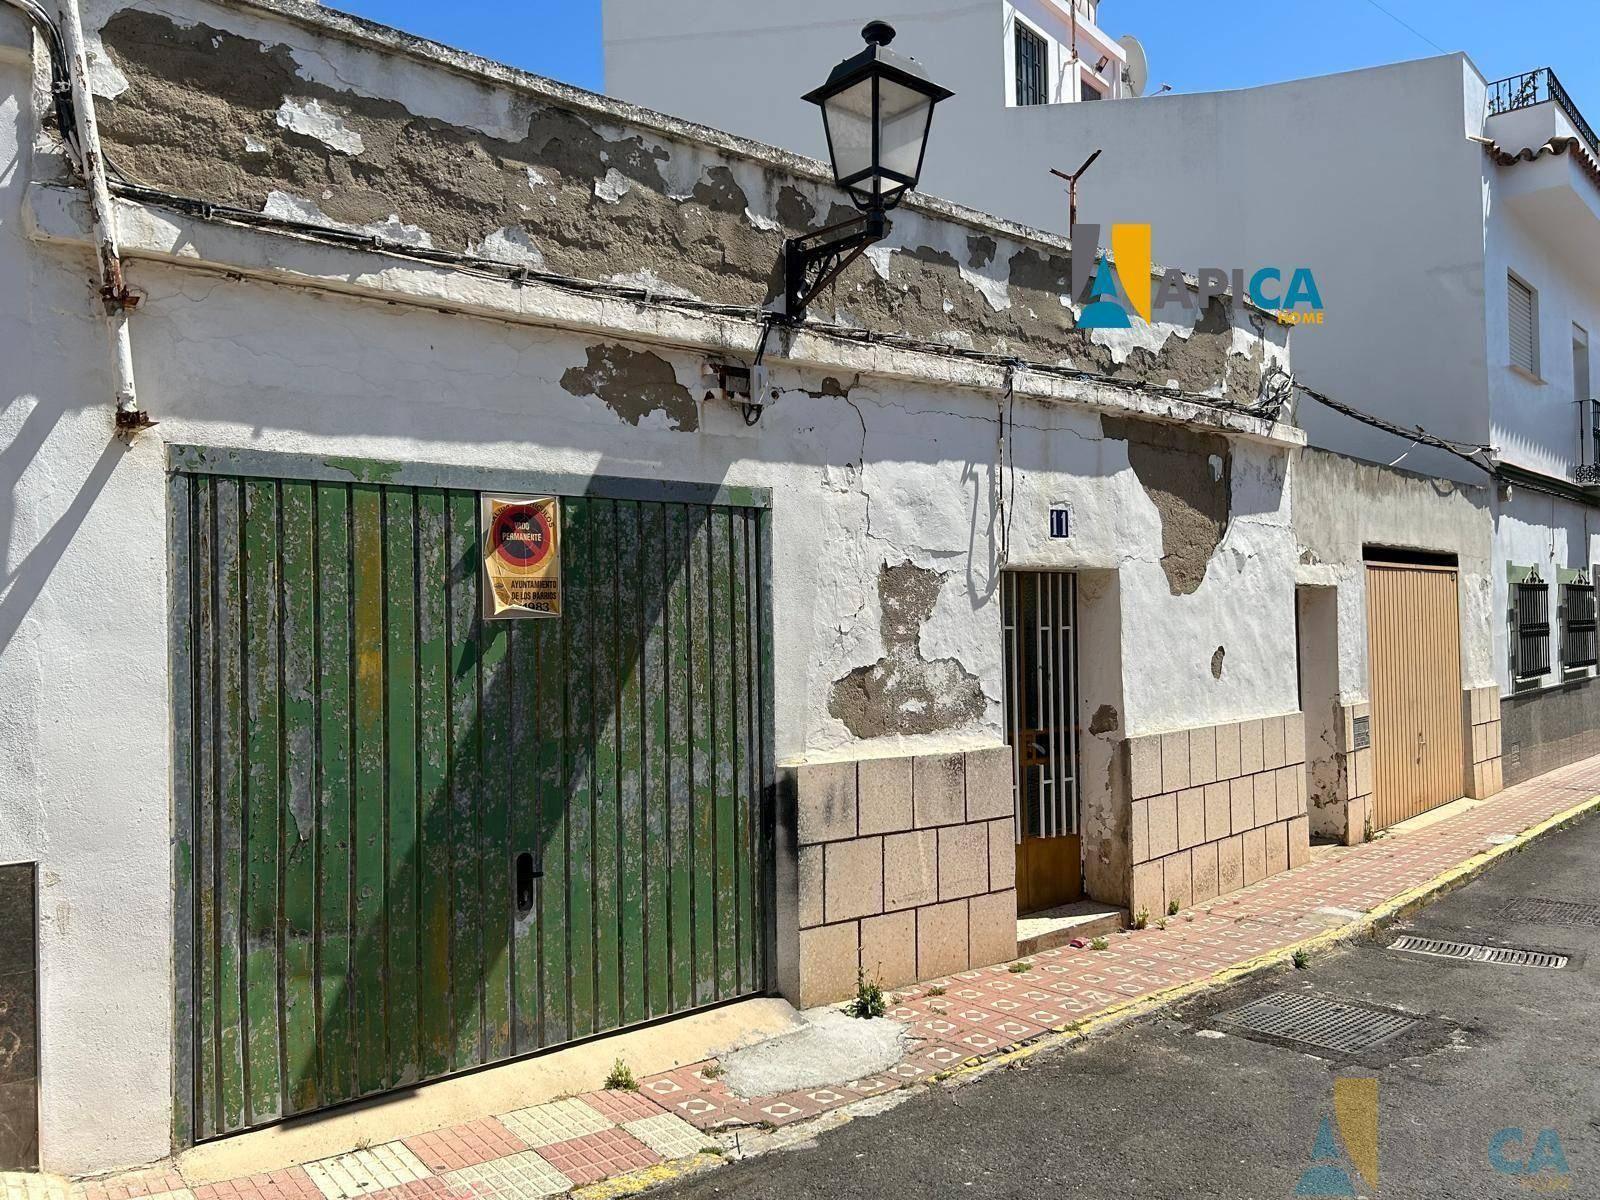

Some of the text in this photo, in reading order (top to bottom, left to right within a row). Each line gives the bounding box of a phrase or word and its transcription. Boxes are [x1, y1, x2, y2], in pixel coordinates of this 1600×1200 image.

[514, 521, 530, 530] VADO
[1052, 511, 1067, 536] 11
[502, 532, 542, 542] PERMANENTE
[511, 580, 557, 588] AYUNTAMIENTO
[511, 591, 557, 600] DE LOS BARRIOS
